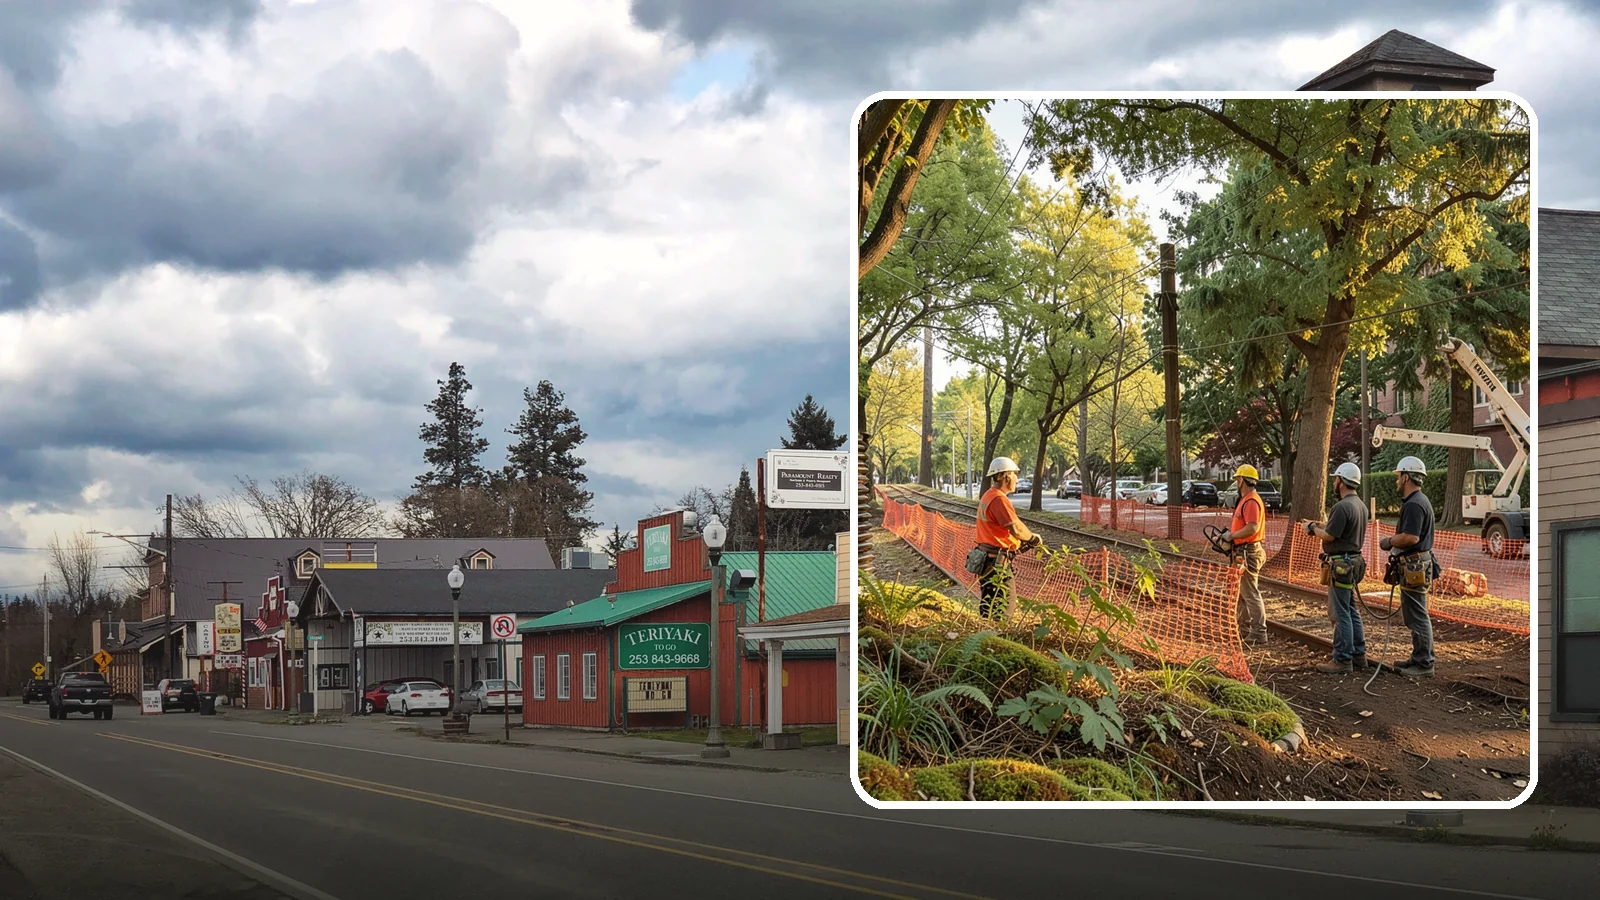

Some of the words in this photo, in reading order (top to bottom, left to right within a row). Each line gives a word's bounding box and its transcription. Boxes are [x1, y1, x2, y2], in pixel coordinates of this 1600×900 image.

[781, 471, 815, 479] PARAMOUNT
[817, 472, 839, 480] REALTY
[625, 627, 702, 646] TERIYAKI
[629, 654, 649, 665] 253
[651, 654, 700, 664] 843-9668
[639, 681, 673, 690] TERIYAKI
